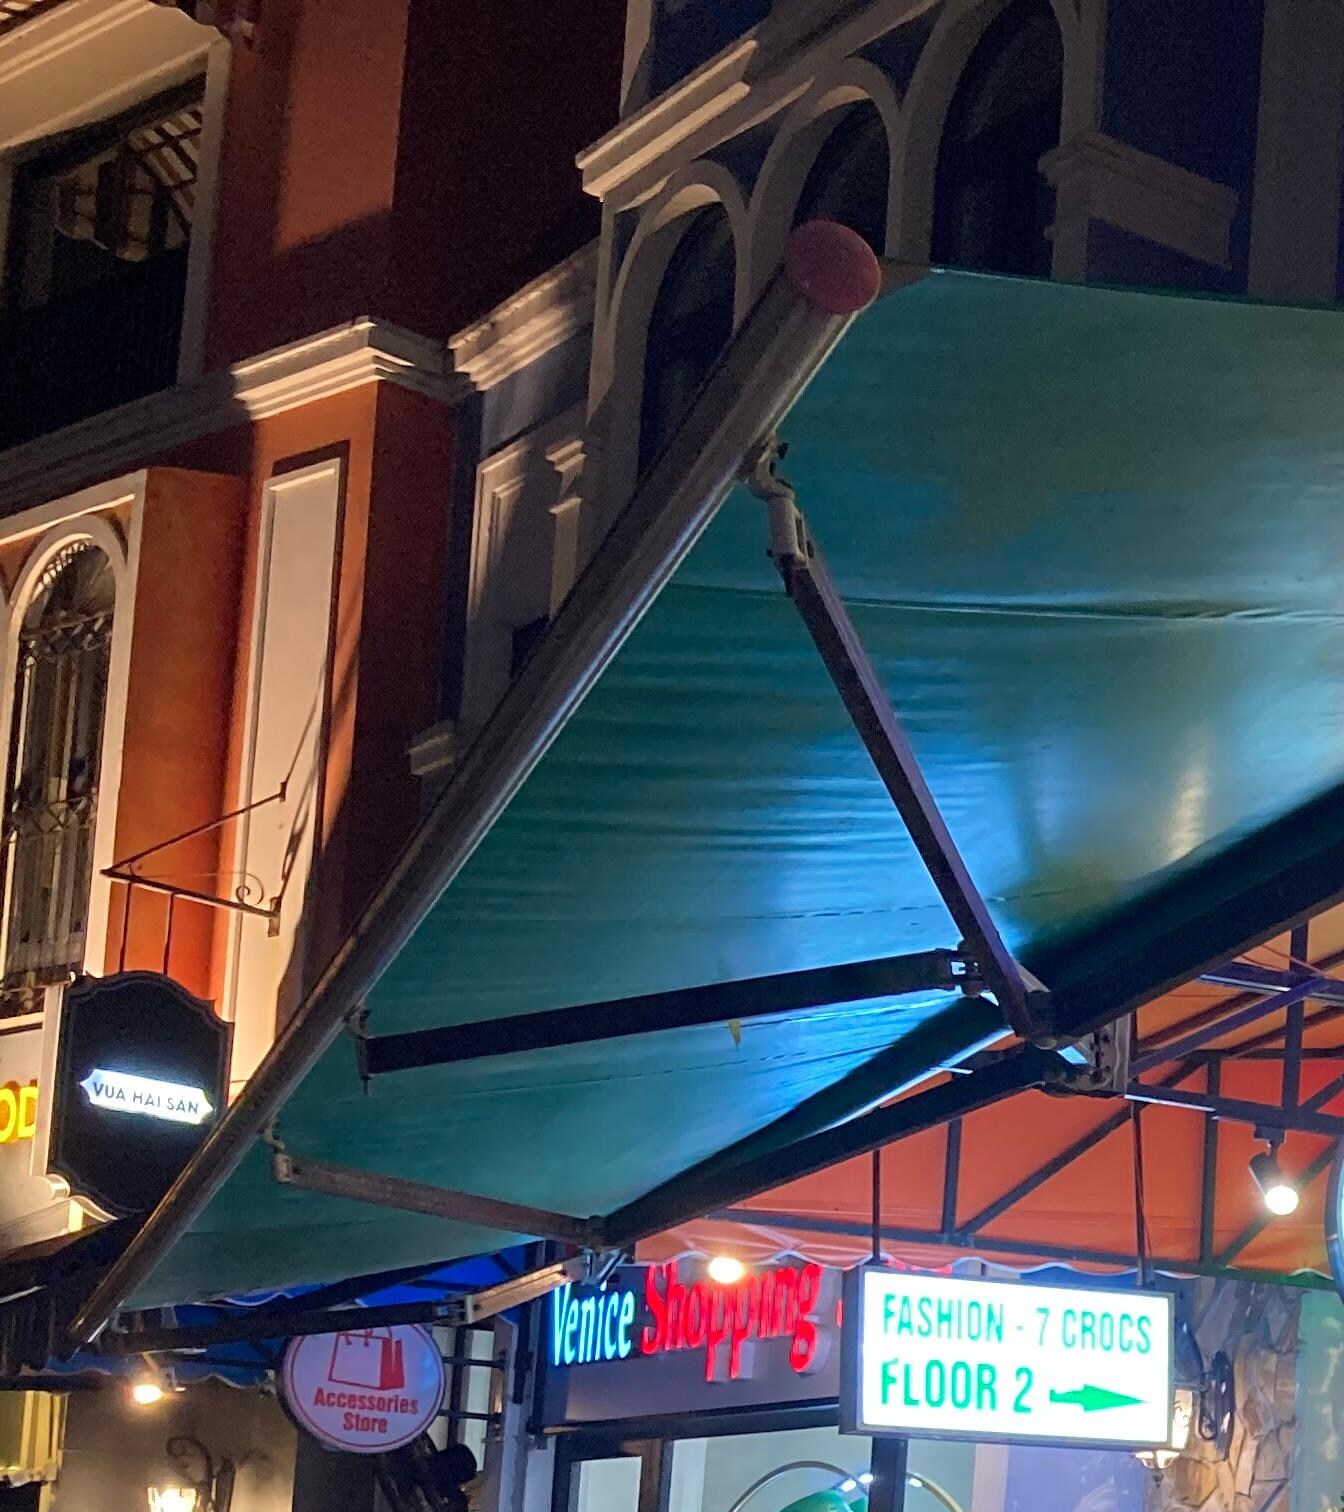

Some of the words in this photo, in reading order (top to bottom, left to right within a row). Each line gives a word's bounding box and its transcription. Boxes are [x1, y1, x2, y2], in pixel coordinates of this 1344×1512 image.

[93, 1082, 125, 1101] VUA
[552, 1283, 634, 1366] Venice
[641, 1262, 824, 1382] Shopping
[883, 1293, 1004, 1343] FASHION
[1036, 1307, 1050, 1346] 7
[1062, 1309, 1152, 1354] CROCS
[314, 1388, 418, 1415] Accessories
[881, 1357, 997, 1412] FLOOR
[1013, 1366, 1034, 1414] 2
[343, 1412, 388, 1434] Store
